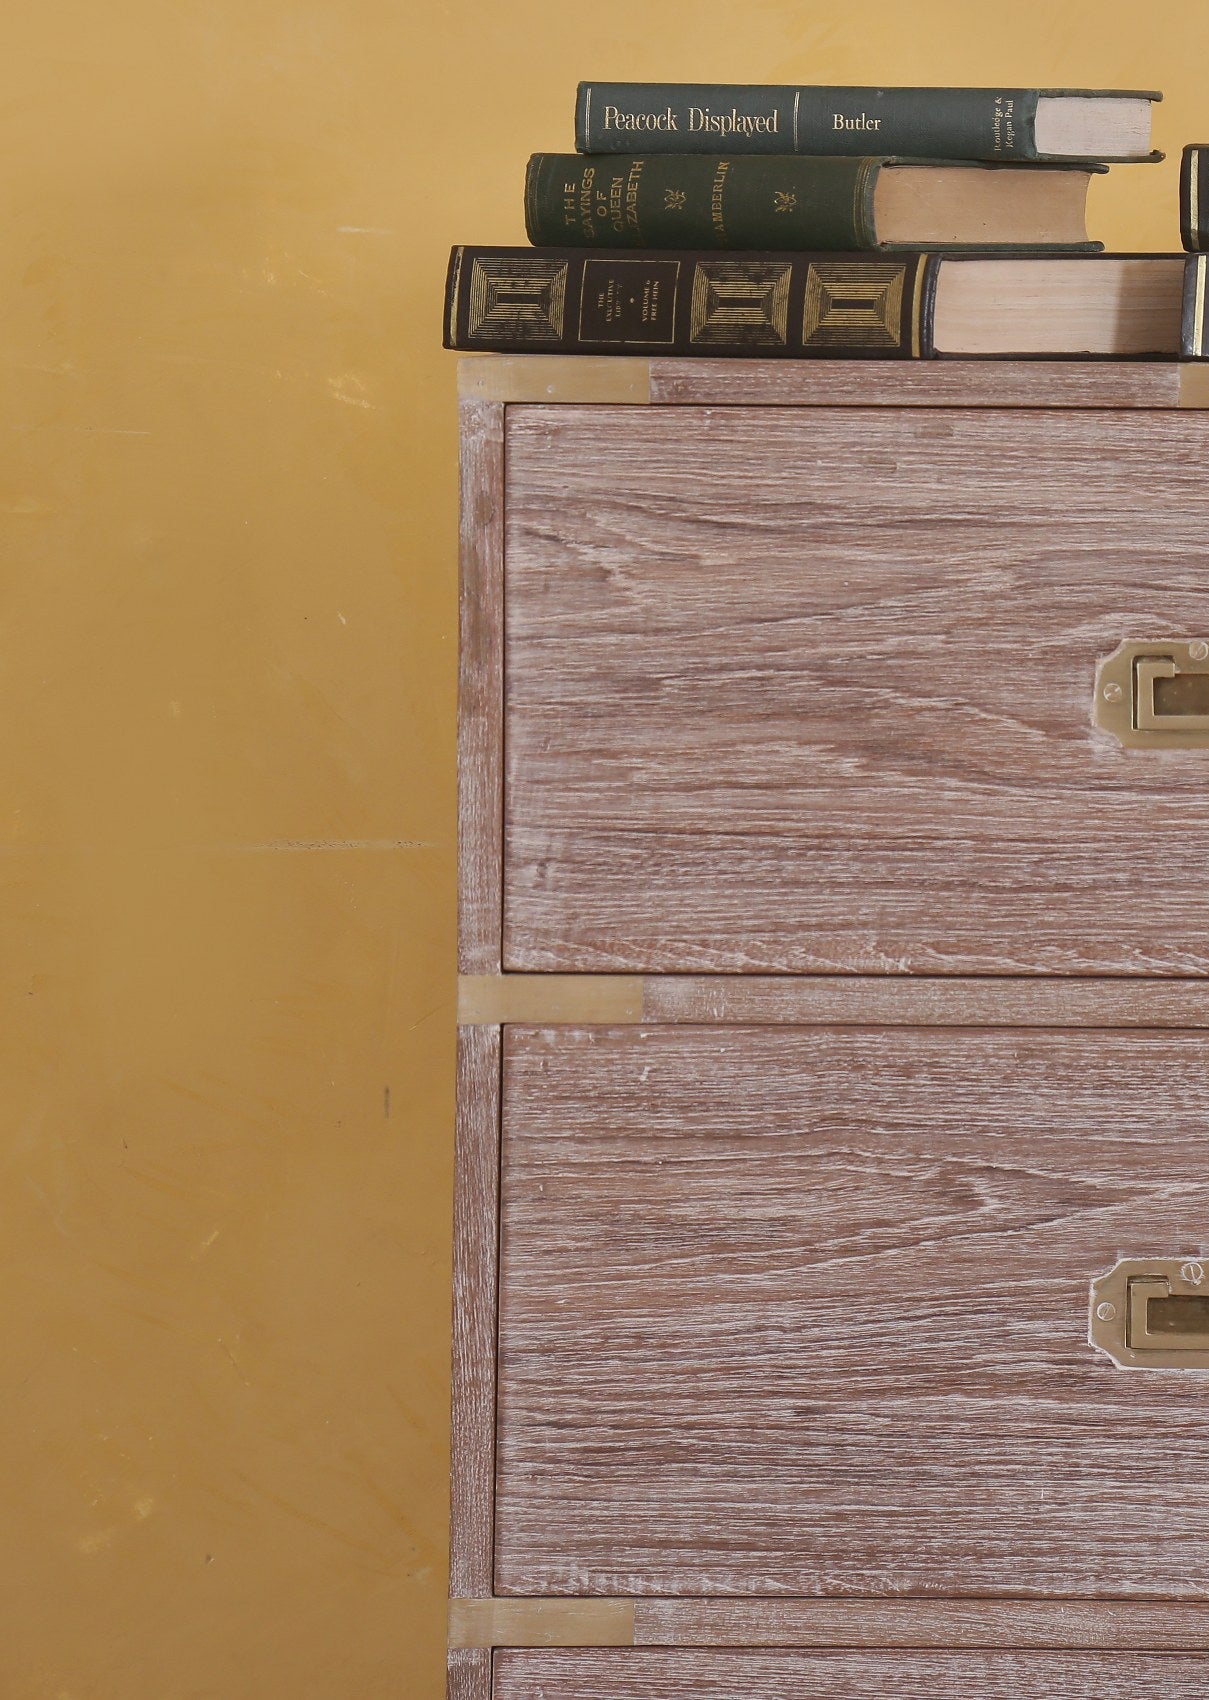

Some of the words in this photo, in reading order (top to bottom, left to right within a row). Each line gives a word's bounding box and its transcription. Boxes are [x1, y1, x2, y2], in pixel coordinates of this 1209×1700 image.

[602, 106, 679, 131] Peacock
[687, 106, 779, 137] Displayed
[831, 113, 882, 132] Butler
[1004, 100, 1014, 118] Paul
[1005, 121, 1015, 148] Kegan
[564, 183, 576, 225] THE
[596, 190, 607, 217] OF
[610, 177, 624, 232] QUEEN
[626, 161, 644, 245] ZABETH
[711, 161, 730, 244] AMBERLIN
